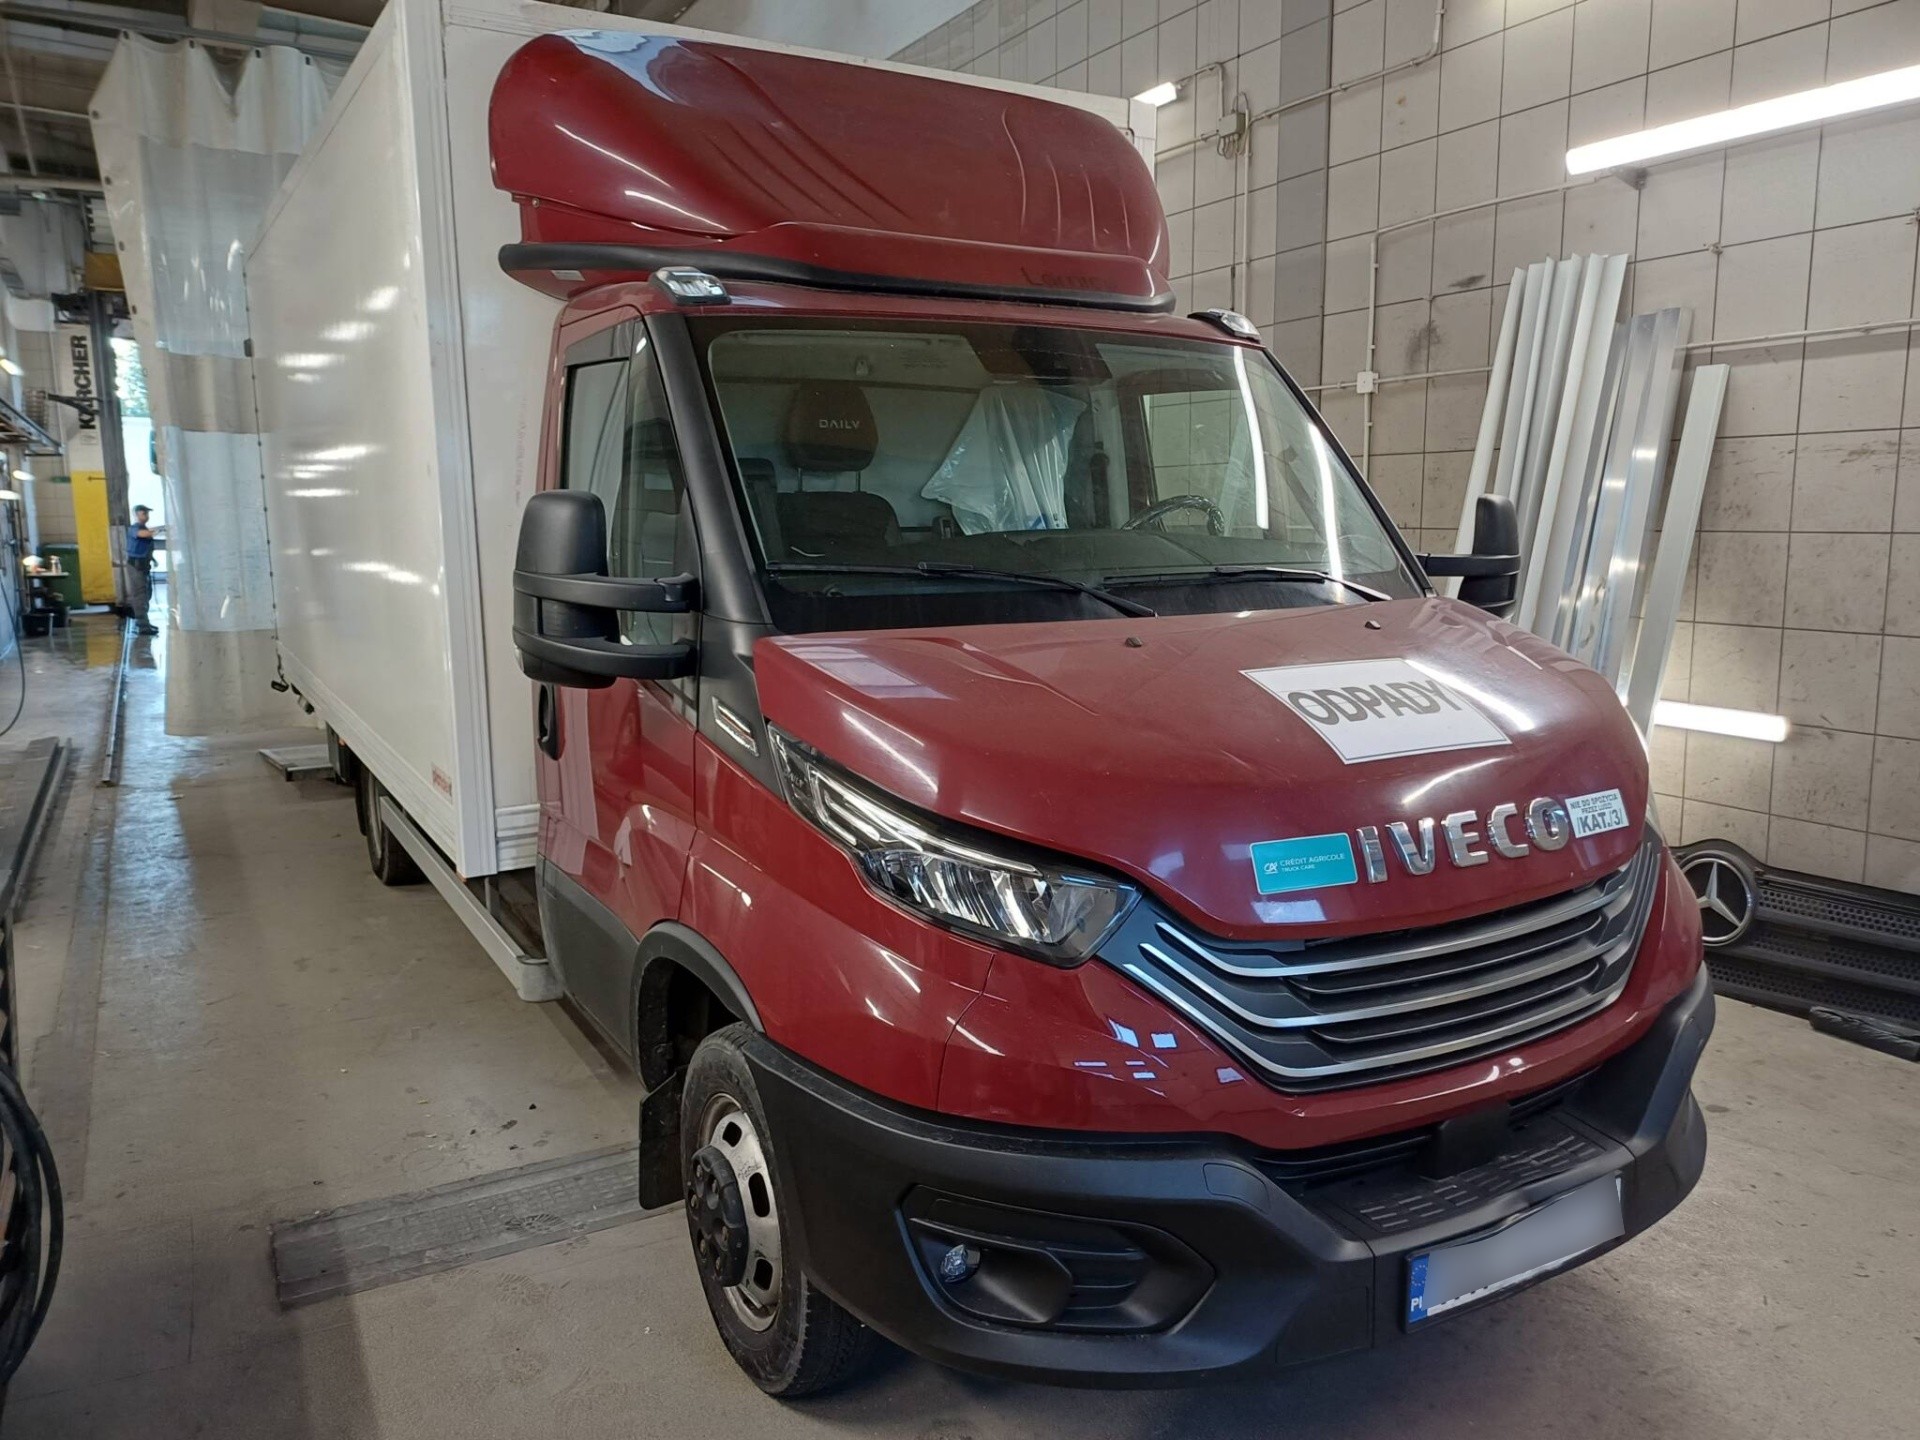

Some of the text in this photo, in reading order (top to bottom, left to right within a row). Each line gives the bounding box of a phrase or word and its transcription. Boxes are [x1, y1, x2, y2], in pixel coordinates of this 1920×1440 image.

[819, 419, 859, 429] DAILY
[1288, 680, 1462, 725] ODPADY
[1356, 797, 1569, 883] IVECO
[1309, 853, 1345, 863] AGRICOLE
